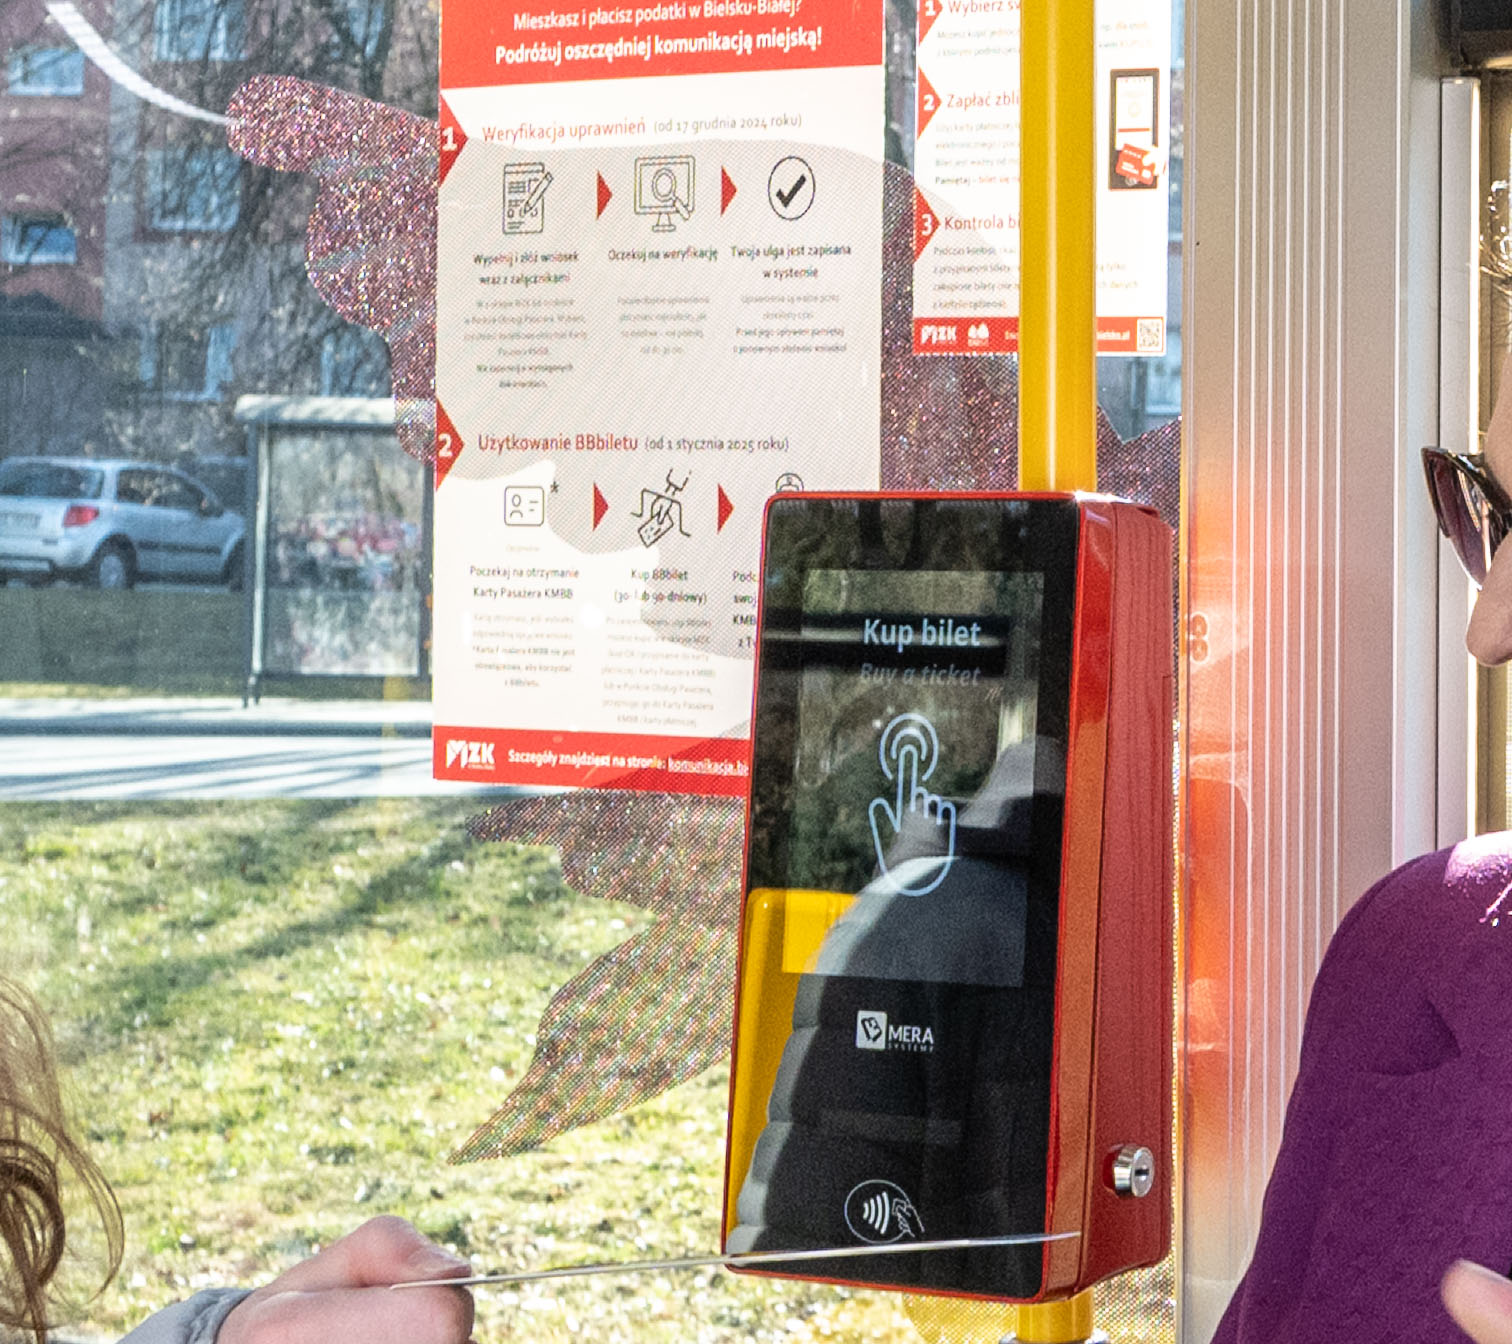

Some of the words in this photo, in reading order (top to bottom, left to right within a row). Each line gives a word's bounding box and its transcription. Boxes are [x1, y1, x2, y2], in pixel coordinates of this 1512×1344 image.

[513, 10, 580, 31] Mieszkasz
[588, 4, 633, 28] płacisz
[635, 1, 687, 24] podatki
[689, 6, 702, 19] w
[925, 0, 936, 16] 1
[495, 41, 563, 65] Podróżuj
[565, 36, 651, 62] oszczędniej
[654, 29, 753, 57] komunikacją
[756, 26, 823, 52] miejską!
[923, 94, 935, 111] 2
[946, 90, 992, 112] Zapłać
[441, 128, 458, 151] 1
[482, 121, 566, 143] Weryfikacja
[569, 118, 646, 138] uprawnień
[653, 117, 672, 135] (od
[691, 115, 737, 133] grudnia
[770, 112, 803, 130] roku)
[921, 213, 933, 236] 3
[944, 214, 1004, 232] Kontrola
[731, 245, 761, 261] Twoja
[438, 434, 453, 458] 2
[477, 432, 571, 455] Użytkowanie
[574, 434, 639, 452] BBbiletu
[644, 436, 663, 453] (od
[674, 437, 725, 454] stycznia
[727, 439, 755, 454] 2025
[756, 436, 790, 453] roku)
[470, 565, 510, 580] Poczekaj
[512, 568, 524, 577] na
[526, 567, 579, 580] otrzymanie
[473, 587, 498, 600] Karty
[500, 587, 542, 599] Pasażera
[863, 617, 914, 654] Kup
[921, 618, 982, 647] bilet
[920, 663, 982, 688] ticket
[446, 739, 495, 768] MZK
[888, 1024, 934, 1045] MERA
